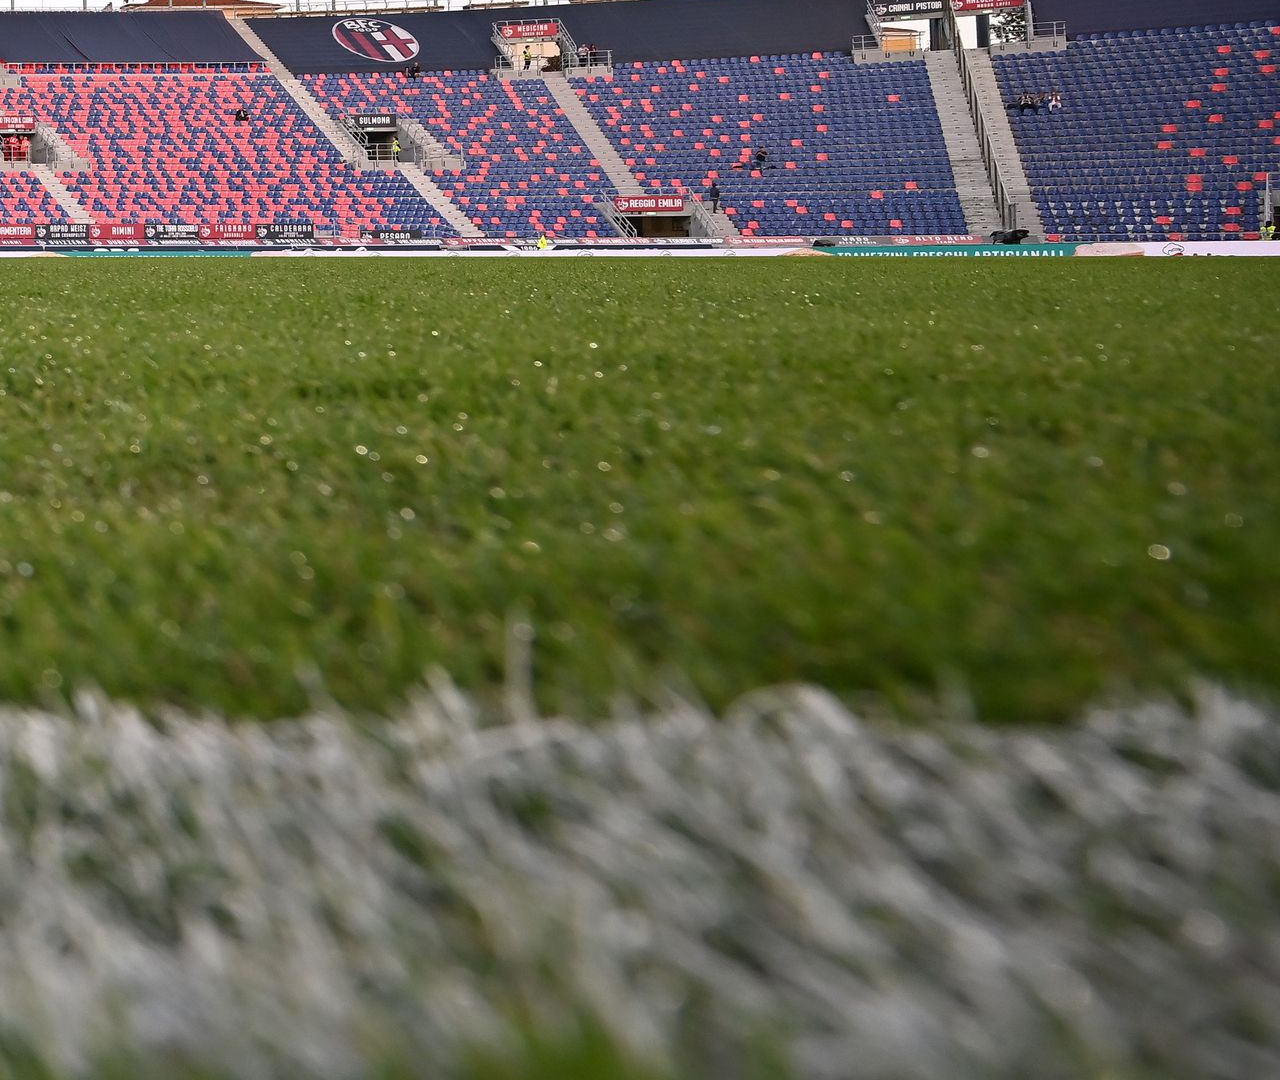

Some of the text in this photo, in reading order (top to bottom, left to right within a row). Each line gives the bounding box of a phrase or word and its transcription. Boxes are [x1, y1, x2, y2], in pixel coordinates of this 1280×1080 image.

[888, 1, 942, 12] CRINALI PISTOIA
[342, 20, 381, 30] BFC
[517, 24, 548, 32] MEDICINA
[359, 116, 390, 124] SULMONA
[629, 199, 682, 208] REGGIO EMILIA
[50, 224, 87, 232] ARPAD WEISZ
[112, 226, 134, 235] RIMINI
[215, 224, 252, 232] FRIGNANO
[270, 224, 311, 232] CALDERARA
